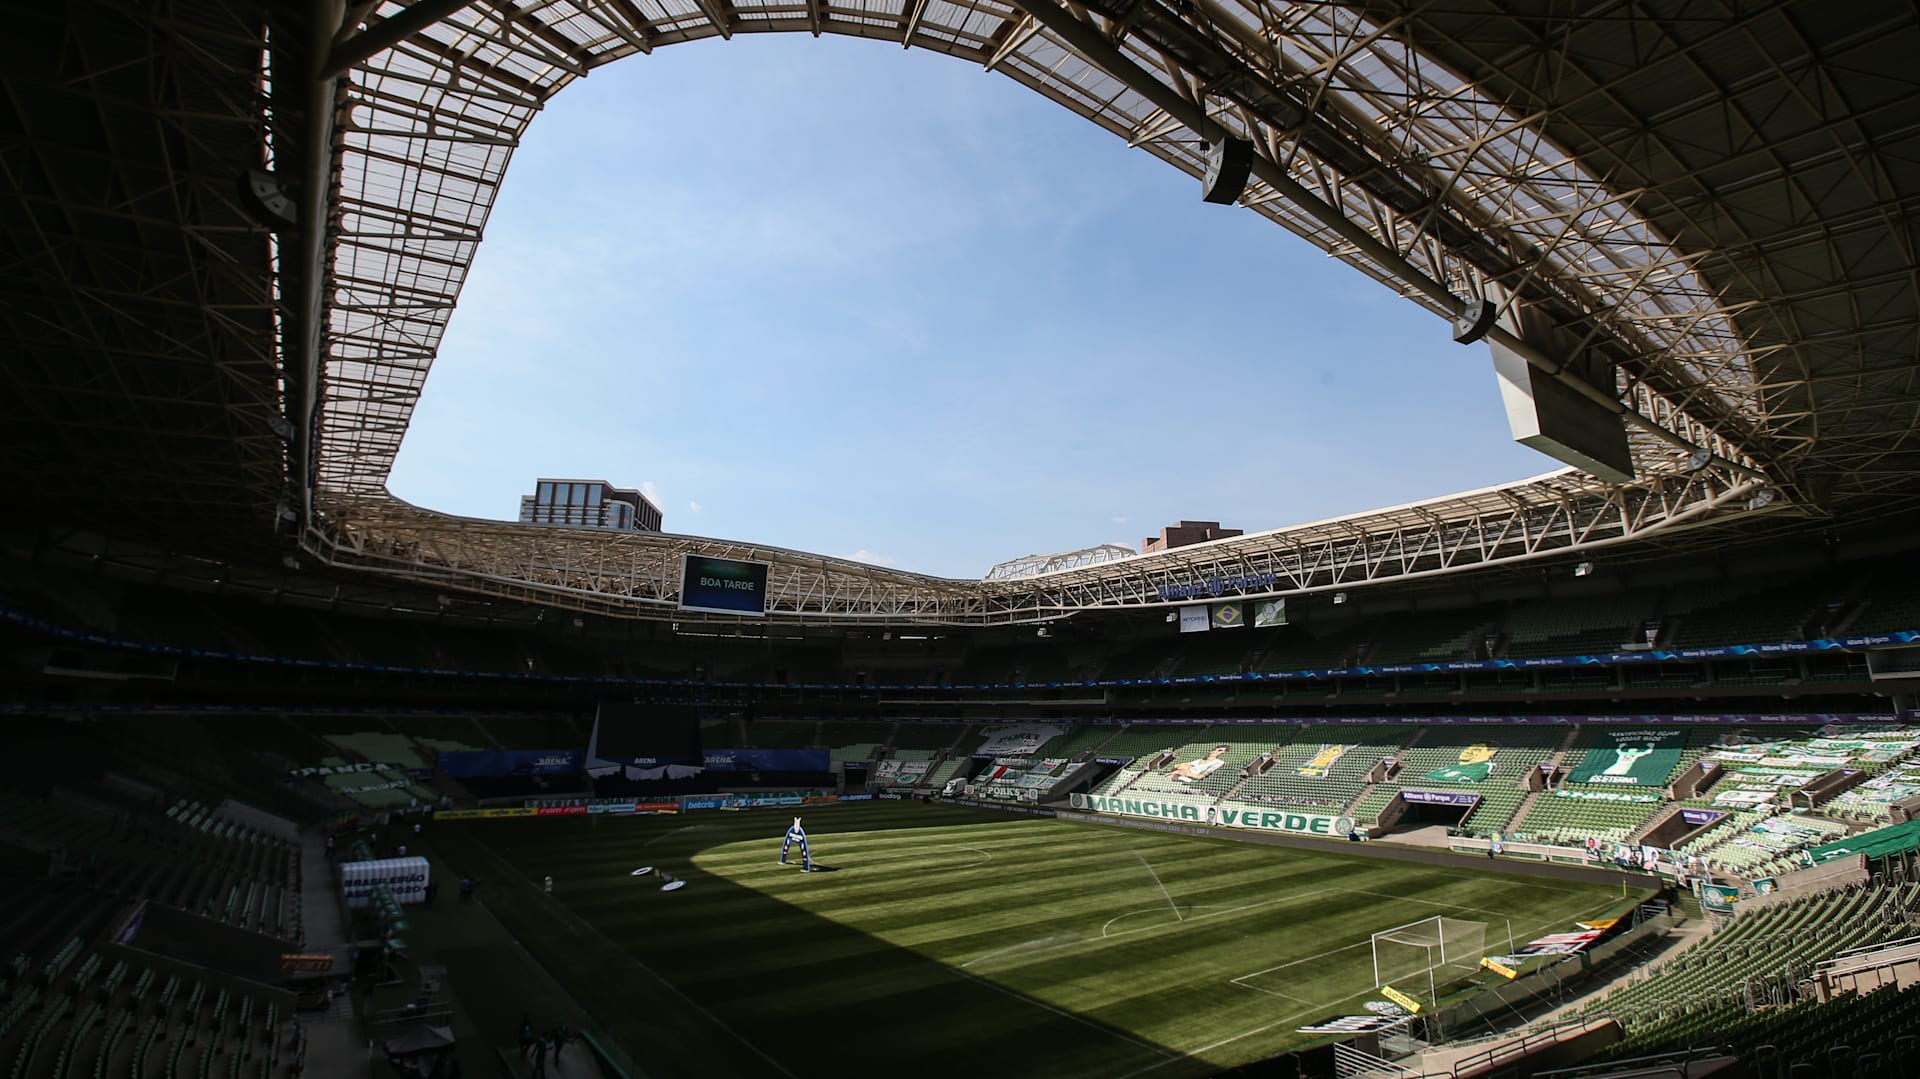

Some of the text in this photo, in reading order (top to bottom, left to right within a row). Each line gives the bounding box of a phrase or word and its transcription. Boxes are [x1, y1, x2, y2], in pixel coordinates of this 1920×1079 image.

[700, 577, 754, 591] BOA TARDE
[1157, 573, 1277, 600] Allianz Parque
[634, 757, 657, 765] ARENA
[1403, 791, 1424, 799] Allianz
[1431, 793, 1451, 802] Parque
[688, 801, 715, 809] betcris
[1089, 795, 1330, 834] MANCHA VERDE
[1683, 812, 1702, 820] Allianz
[344, 874, 425, 887] BRASILEIRÃO
